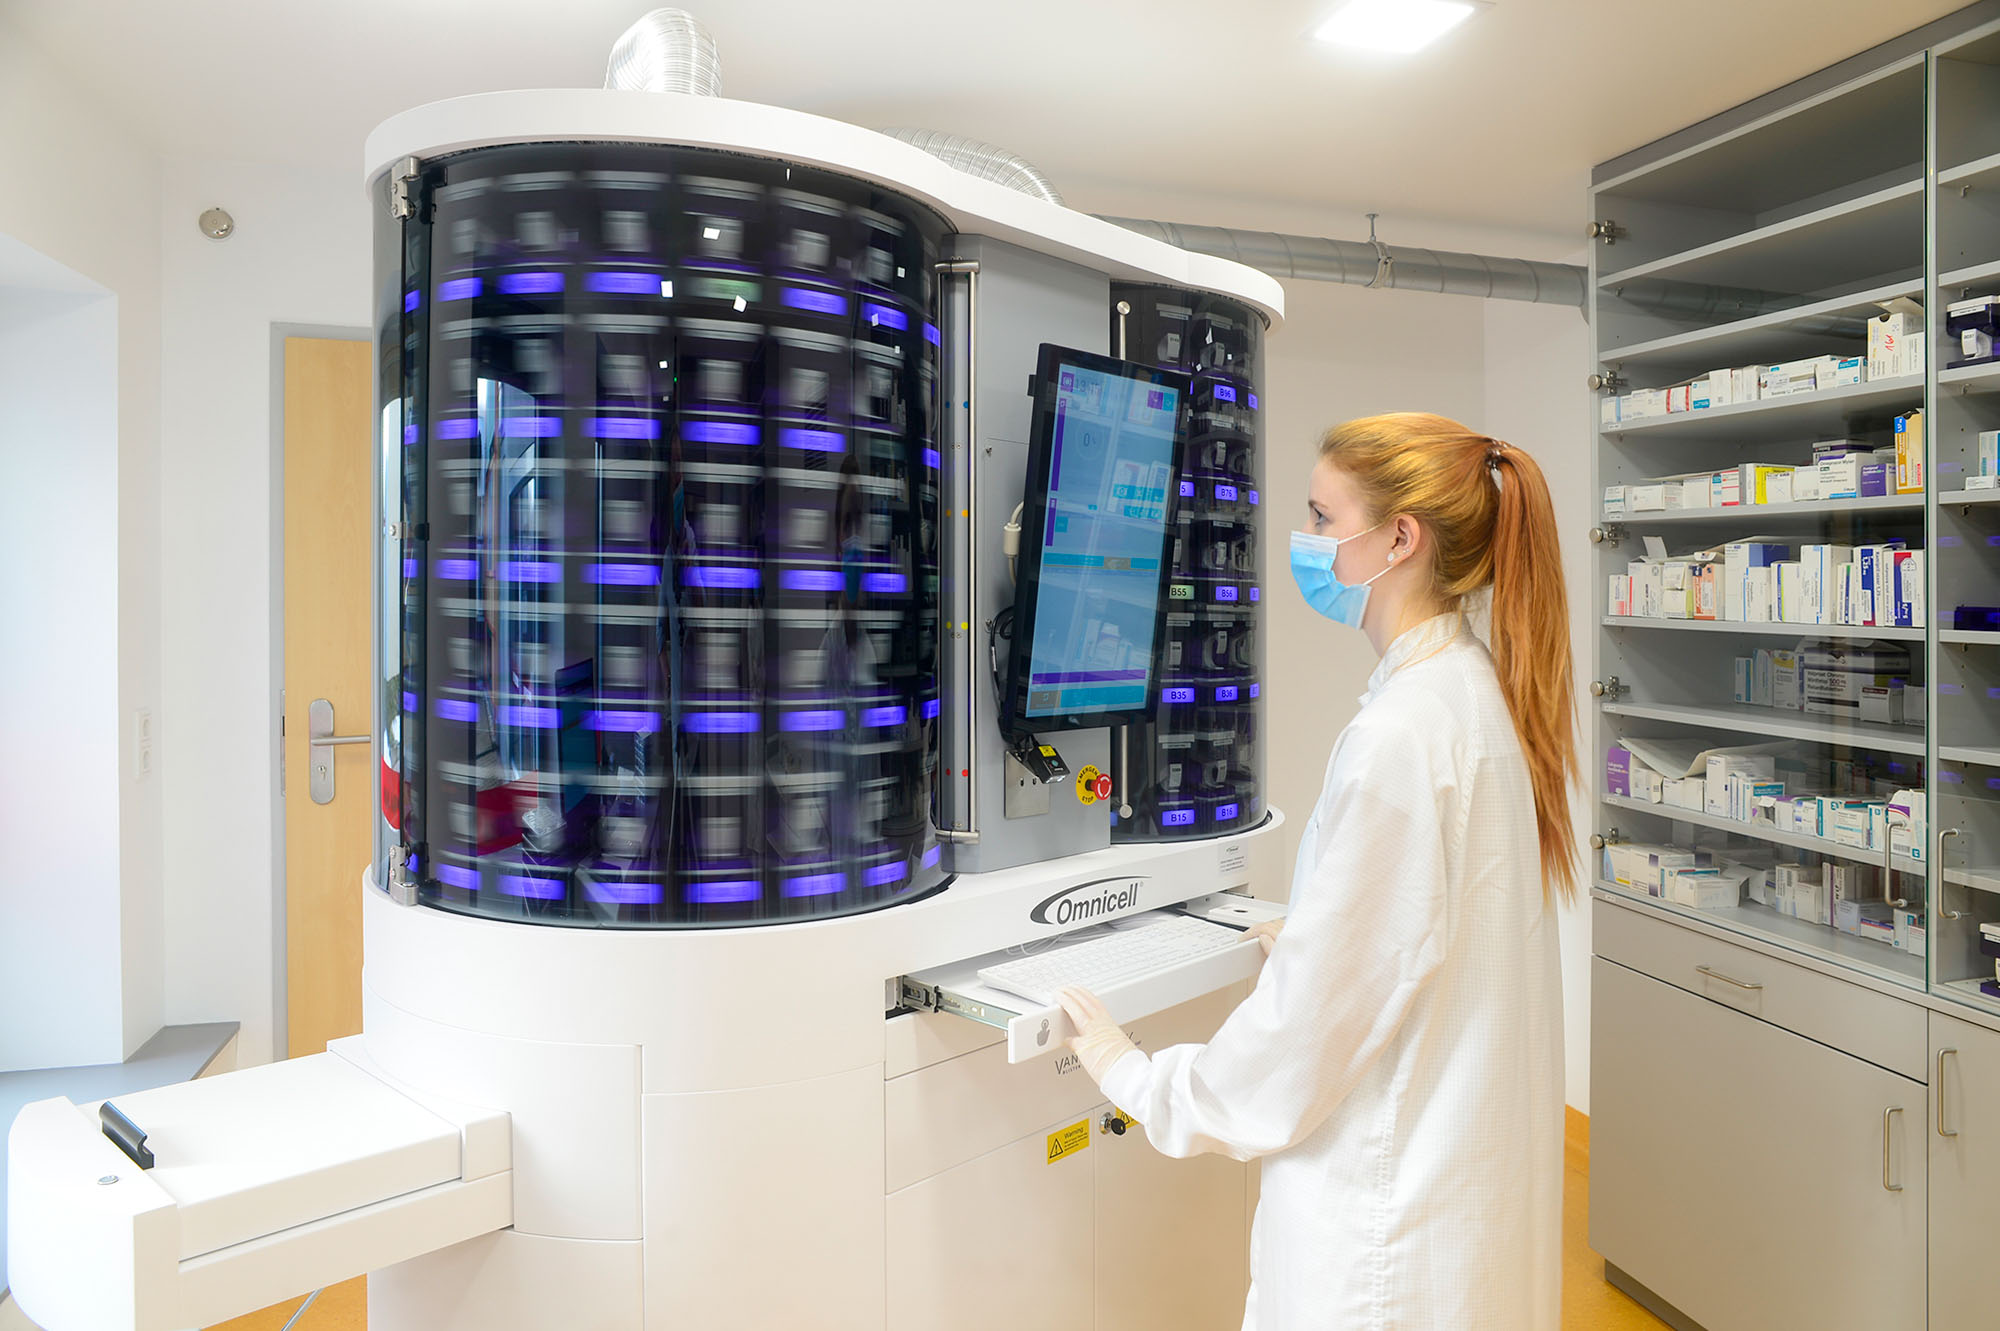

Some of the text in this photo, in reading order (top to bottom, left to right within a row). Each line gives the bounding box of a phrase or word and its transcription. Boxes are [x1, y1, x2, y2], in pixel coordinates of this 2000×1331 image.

[1171, 587, 1187, 597] B55
[1171, 691, 1187, 700] B35
[1221, 689, 1233, 698] B36
[1082, 795, 1094, 803] STOP
[1221, 807, 1233, 817] B16
[1171, 813, 1187, 823] B15
[1057, 883, 1139, 926] Omnicell
[1064, 1127, 1084, 1139] Warning
